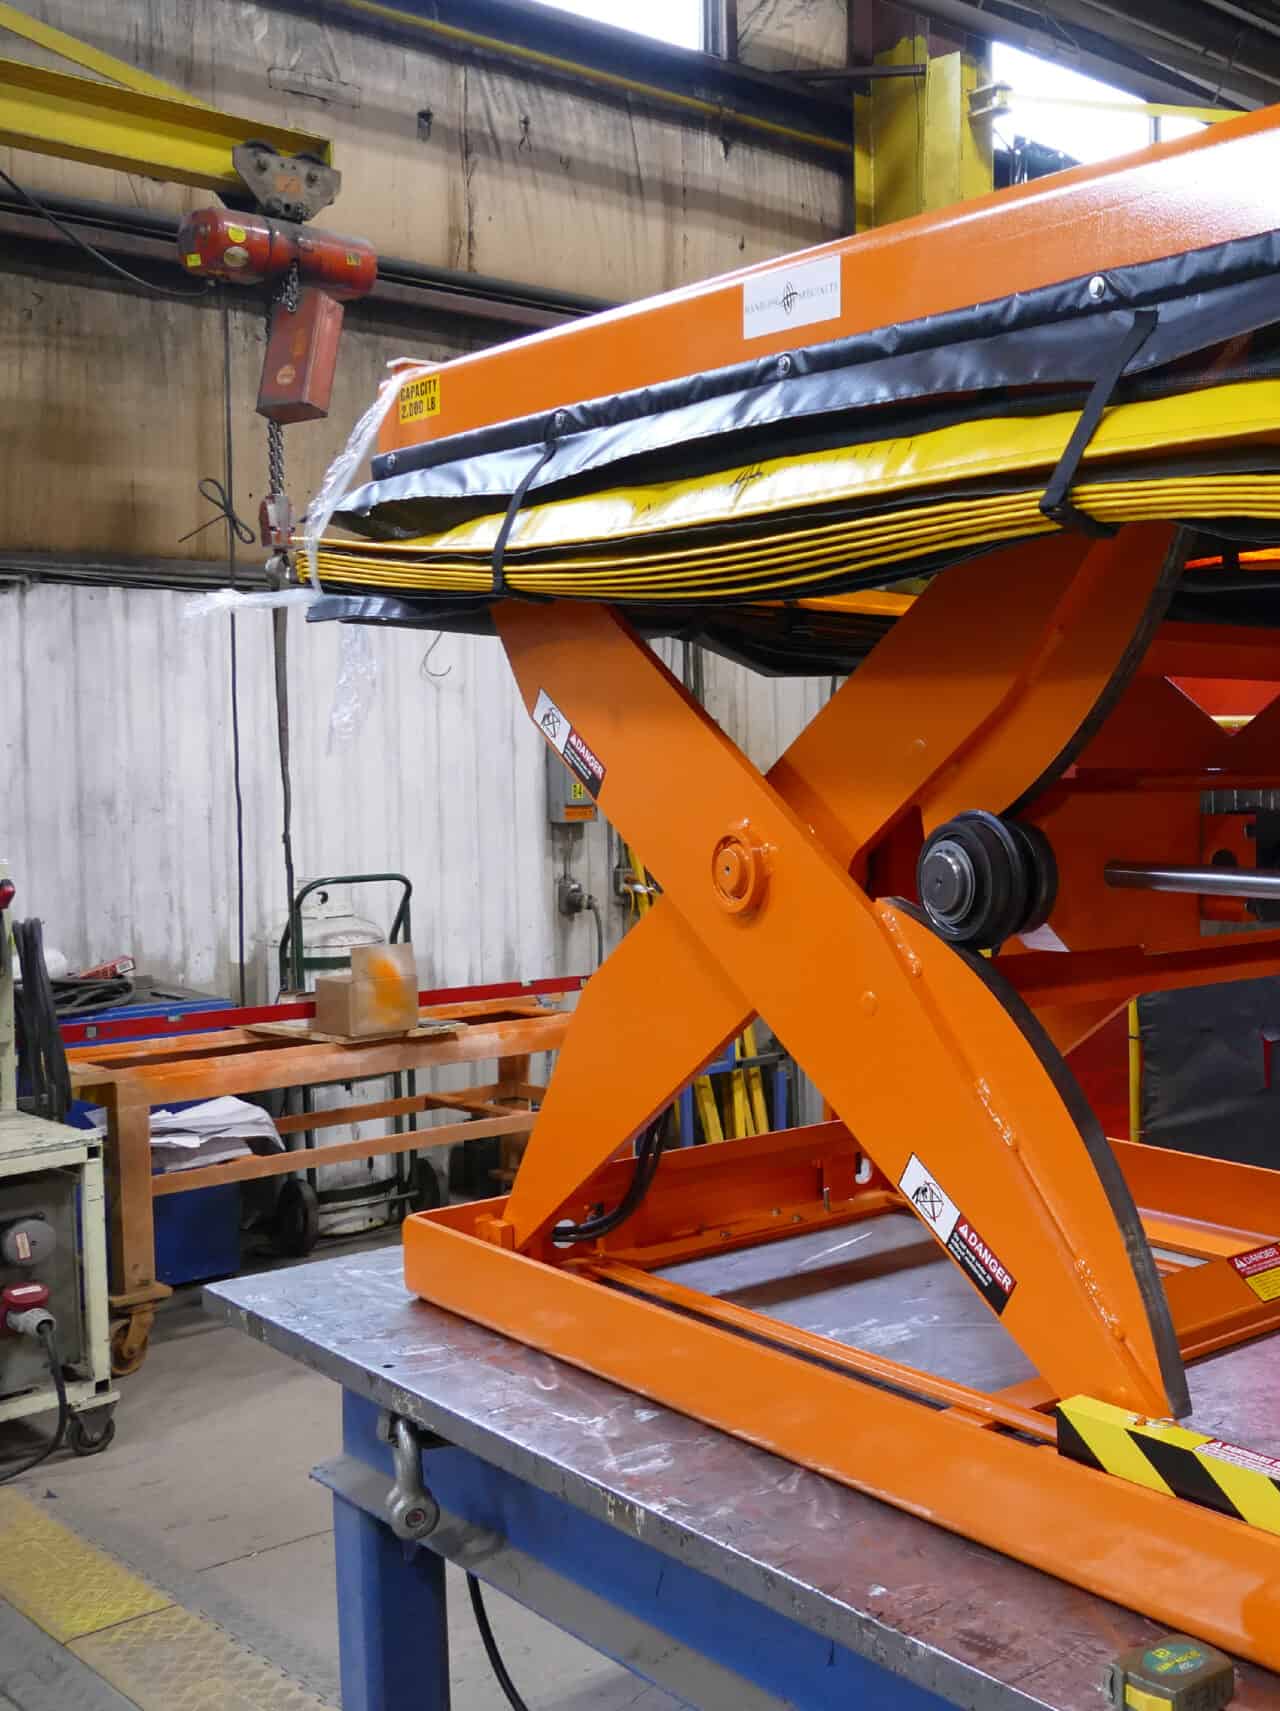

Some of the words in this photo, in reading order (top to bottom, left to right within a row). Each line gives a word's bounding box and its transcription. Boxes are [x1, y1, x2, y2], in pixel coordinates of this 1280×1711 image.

[400, 379, 437, 401] CAPACITY
[426, 396, 436, 411] LB
[575, 738, 604, 780] DANGER
[967, 1232, 1012, 1291] DANGER
[1242, 1247, 1279, 1265] DANGER
